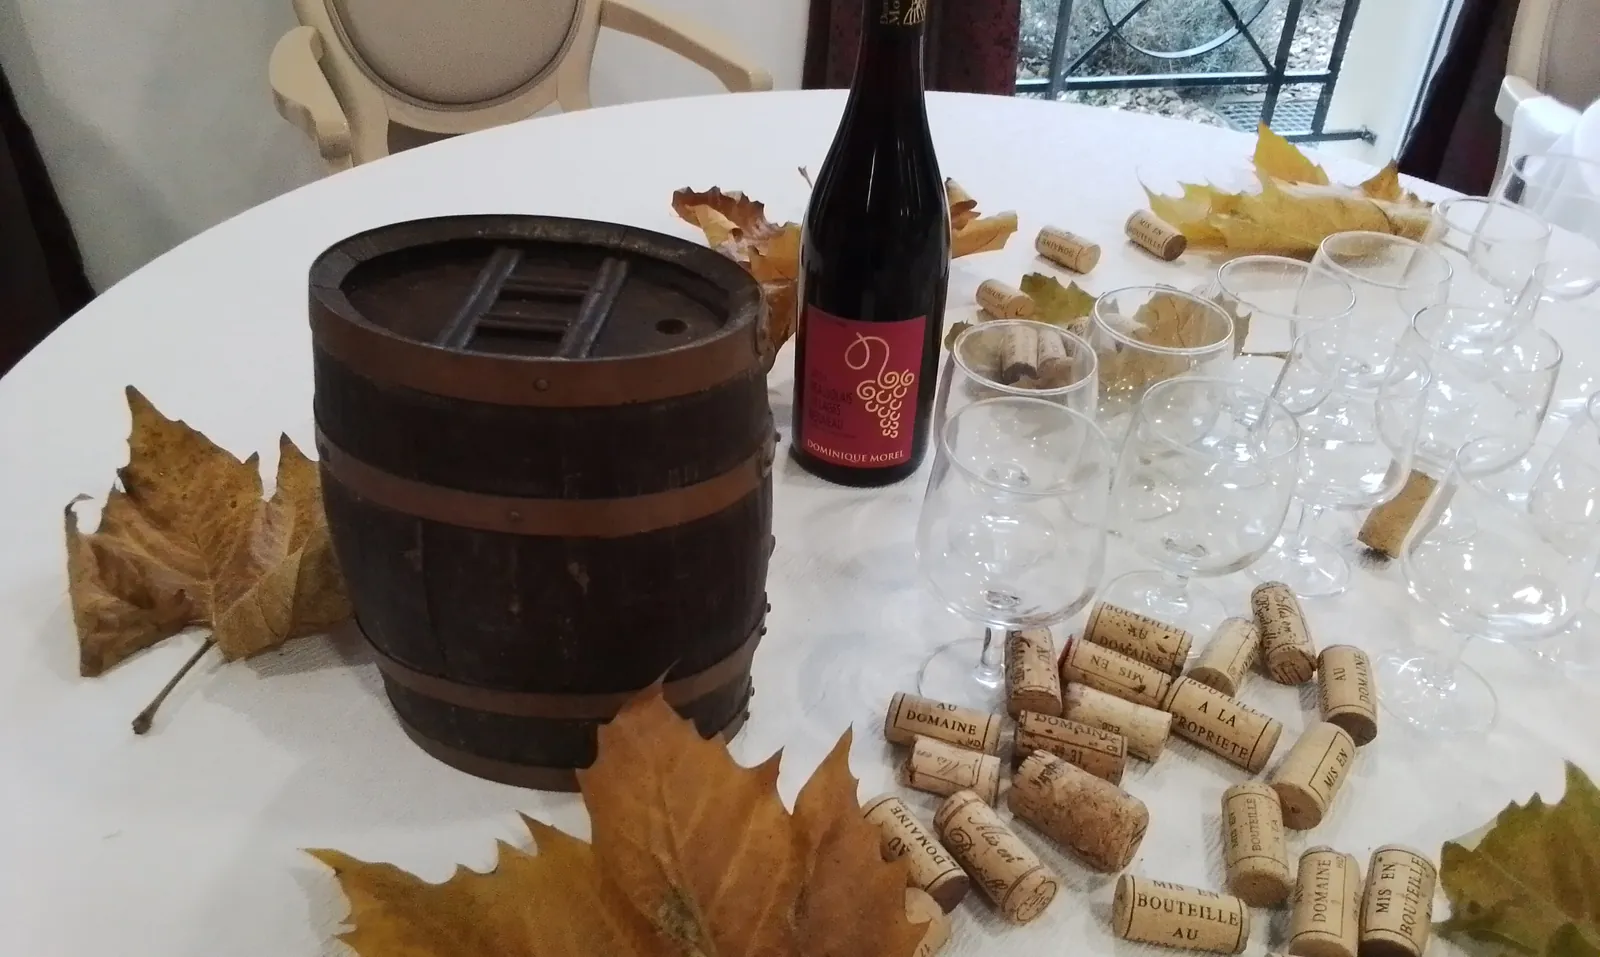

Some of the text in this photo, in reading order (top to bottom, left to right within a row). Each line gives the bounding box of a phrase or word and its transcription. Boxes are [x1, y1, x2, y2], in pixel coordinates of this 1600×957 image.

[807, 438, 905, 463] DOMINIQUE MOREL
[906, 710, 977, 736] DOMAINE
[1171, 711, 1249, 760] PROPRIETE
[1217, 708, 1236, 728] LA
[1323, 749, 1349, 791] MIS EN
[890, 806, 946, 866] DOMAINE
[1246, 797, 1262, 852] BOUTEILLE
[1152, 879, 1185, 892] MIS
[1312, 859, 1332, 923] DOMAINE
[1375, 863, 1396, 914] MIS EN
[1400, 856, 1425, 937] BOUTEILLE
[1136, 892, 1240, 927] BOUTEILLE
[1172, 926, 1200, 941] AU
